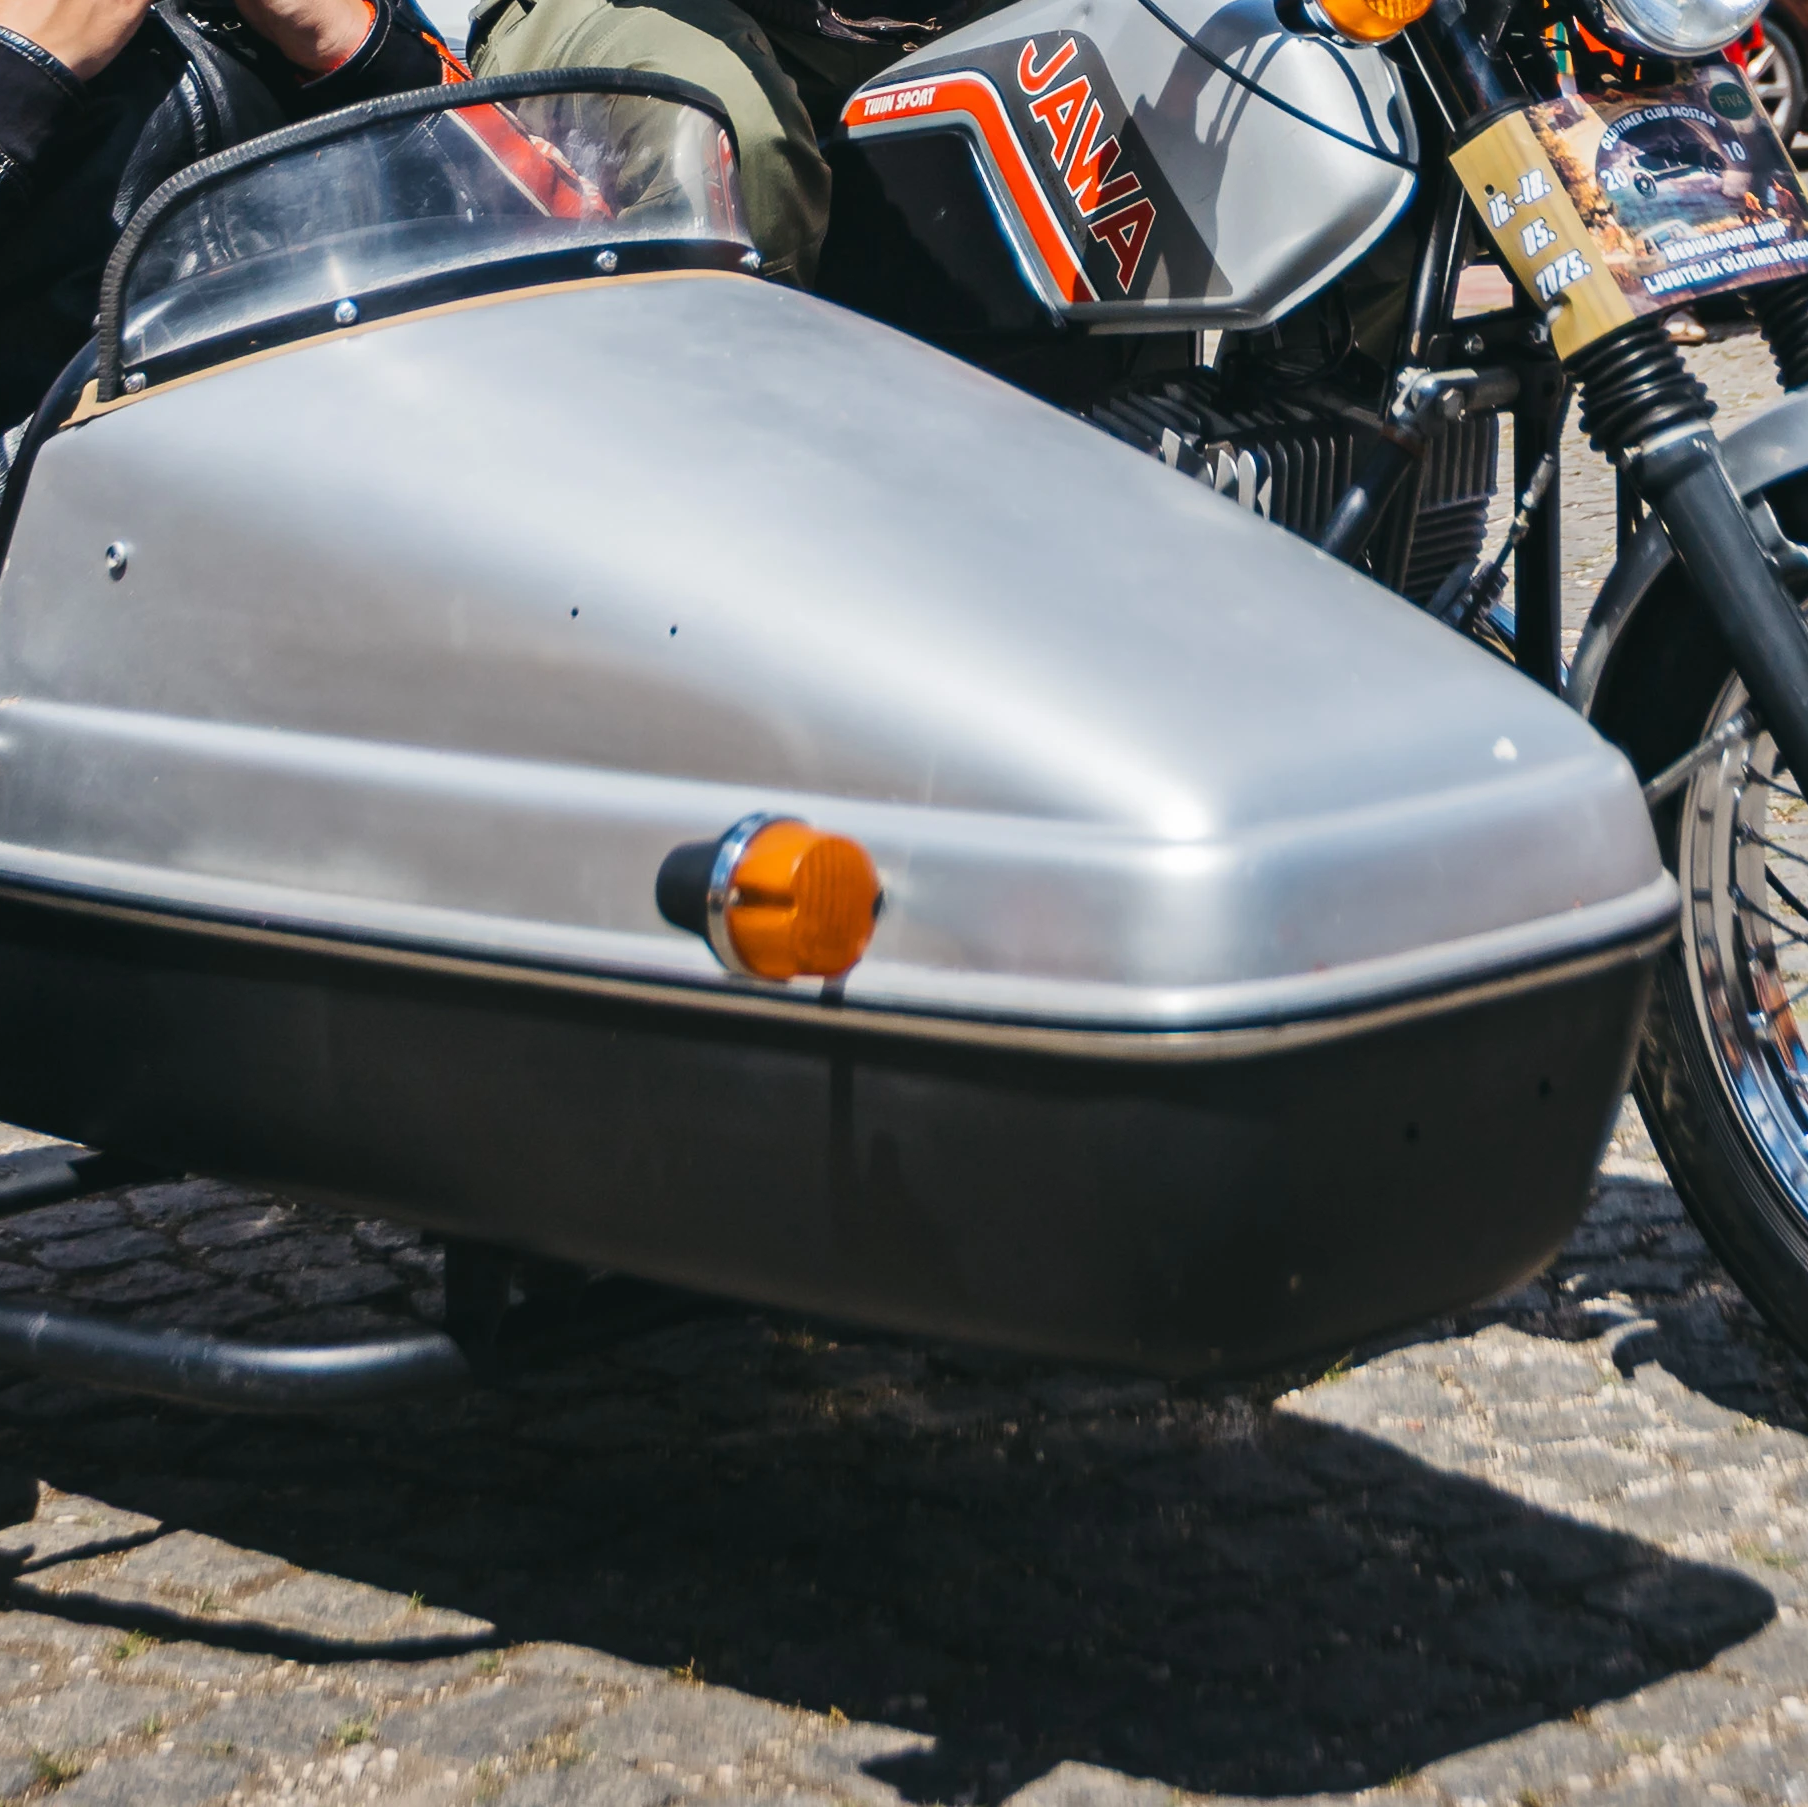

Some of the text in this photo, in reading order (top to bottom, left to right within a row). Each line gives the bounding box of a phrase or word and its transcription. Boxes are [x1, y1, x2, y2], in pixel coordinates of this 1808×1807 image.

[864, 87, 936, 116] TWIN SPORT
[1716, 92, 1746, 109] FIVA
[1600, 105, 1717, 151] OLDTIMER CLUB MOSTAR
[1017, 37, 1156, 295] JAWA
[1599, 142, 1747, 192] 20 10
[1754, 220, 1787, 241] SKUP
[1721, 246, 1782, 273] OLDTIMER
